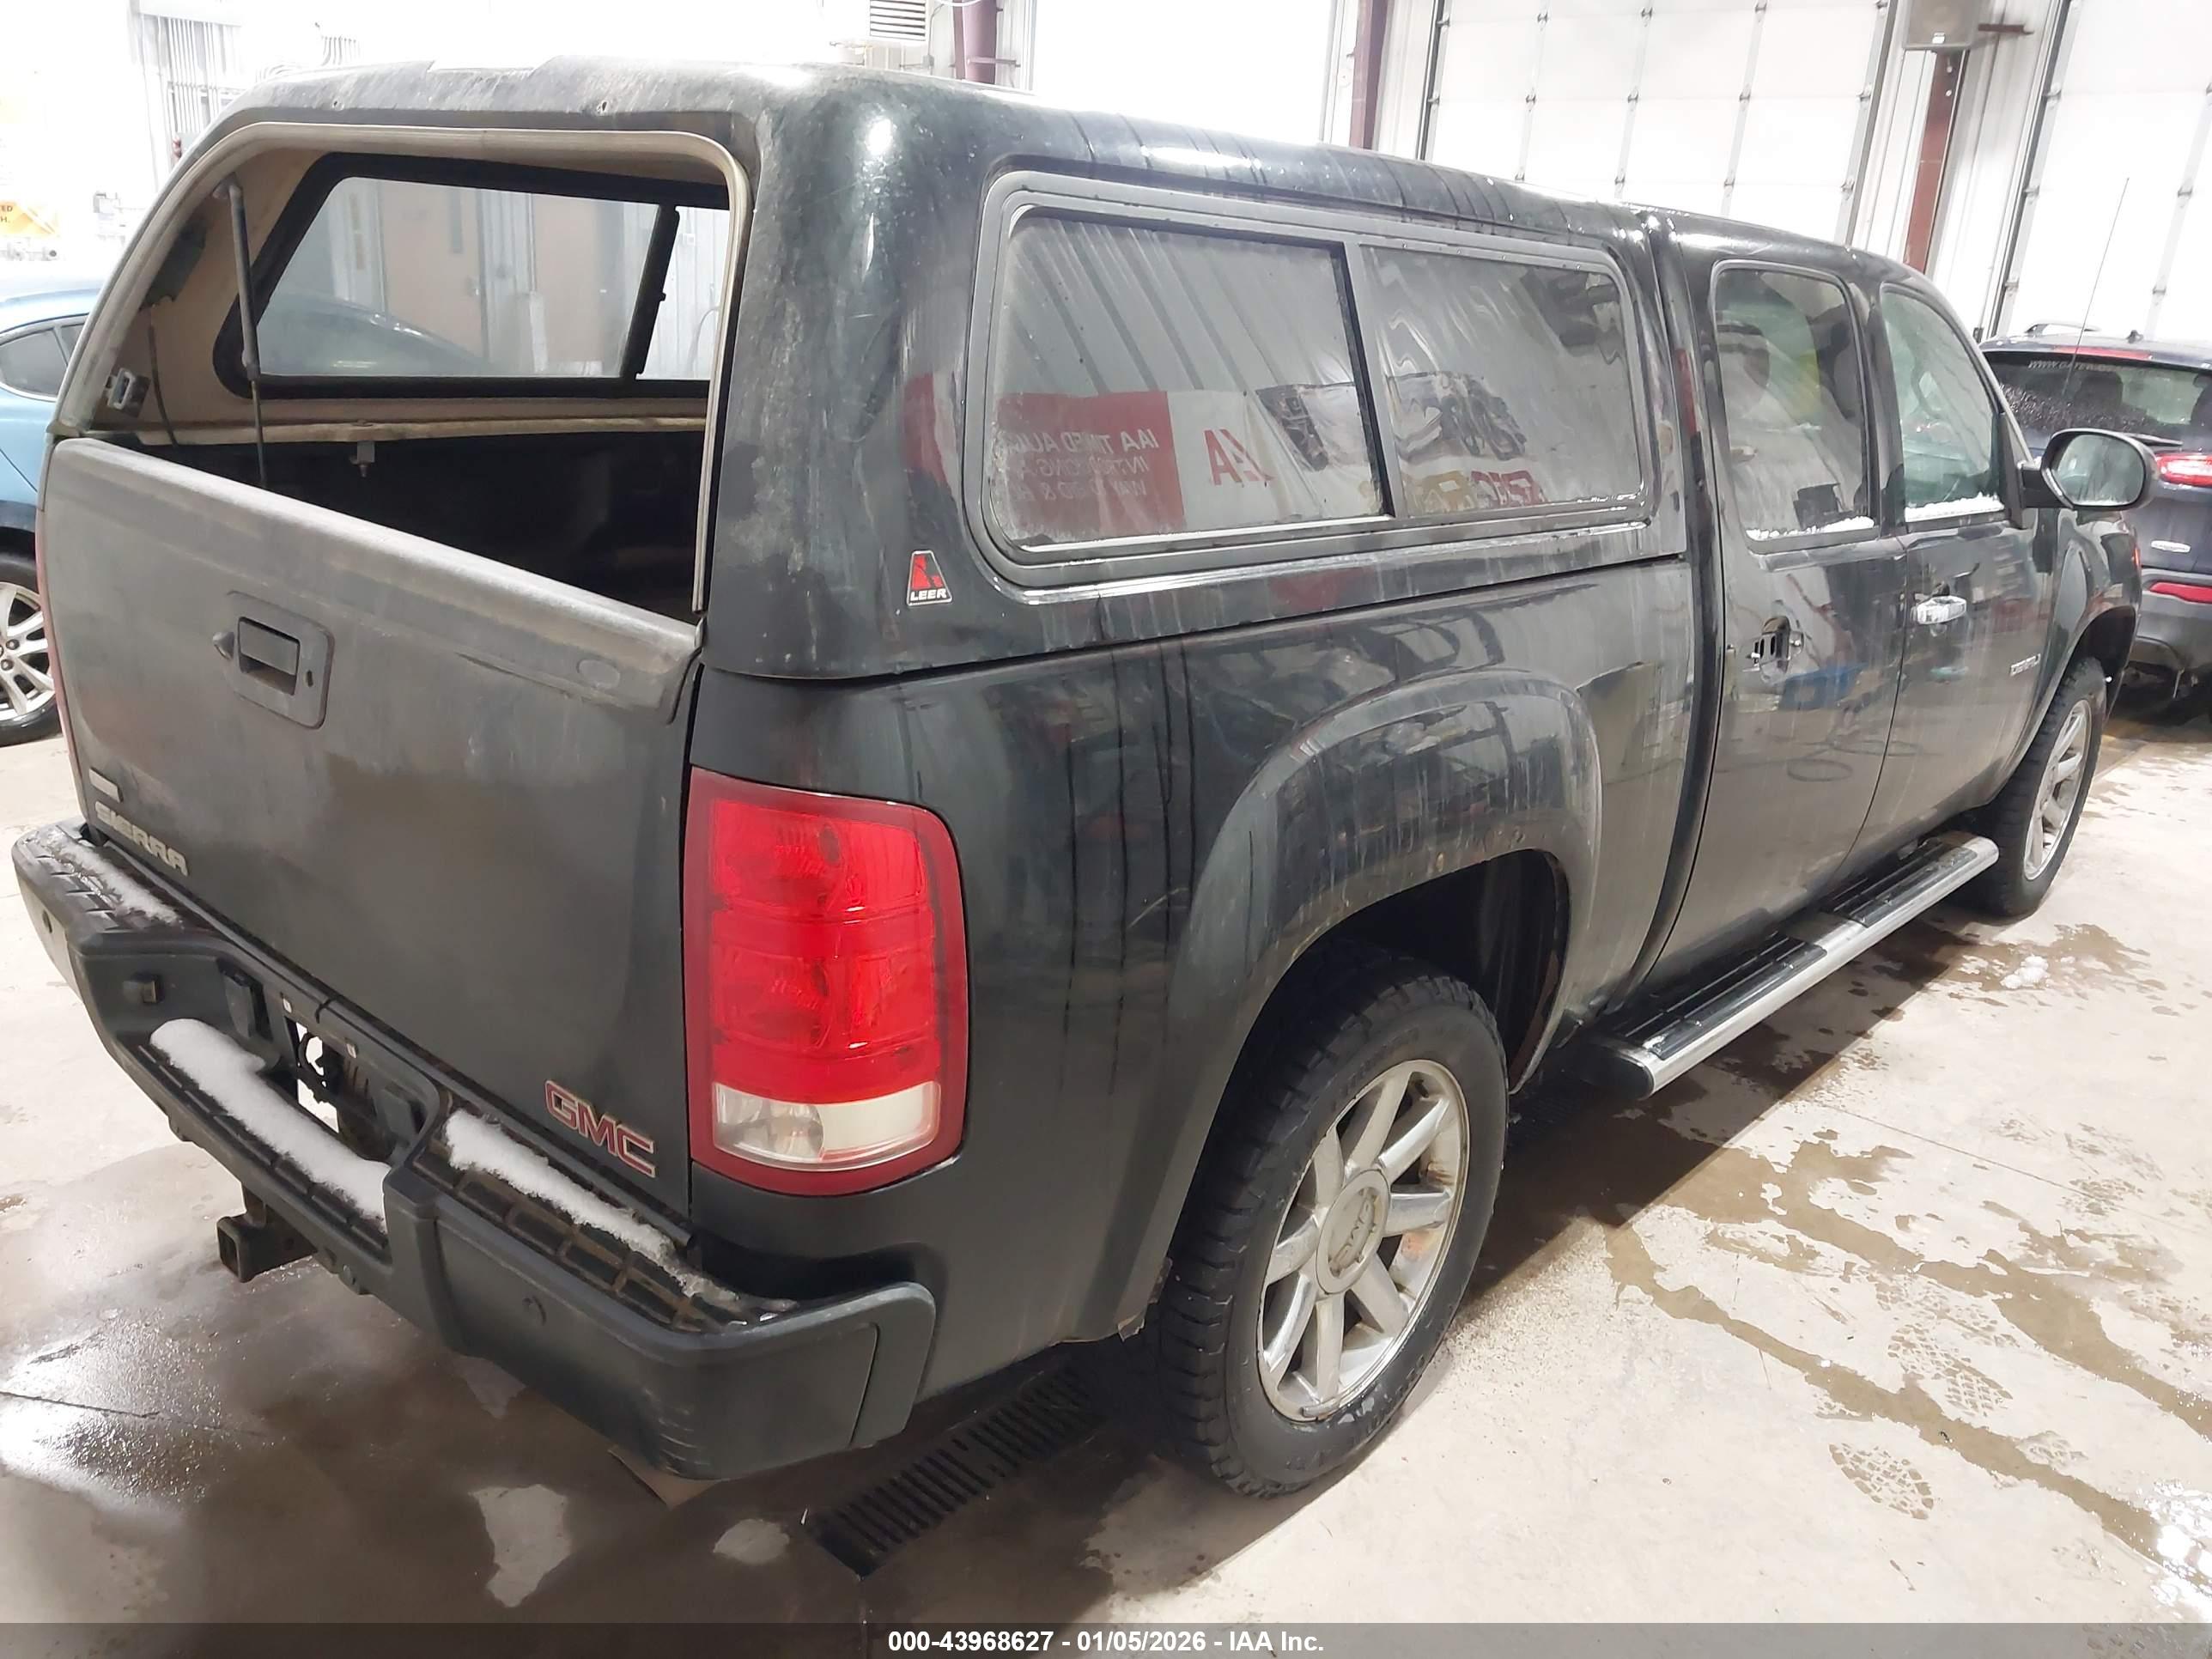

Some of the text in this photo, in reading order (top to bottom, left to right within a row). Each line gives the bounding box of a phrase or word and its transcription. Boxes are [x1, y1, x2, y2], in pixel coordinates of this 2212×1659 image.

[910, 588, 947, 602] LEER
[94, 800, 189, 877] SIERRA
[544, 1080, 655, 1178] GMC
